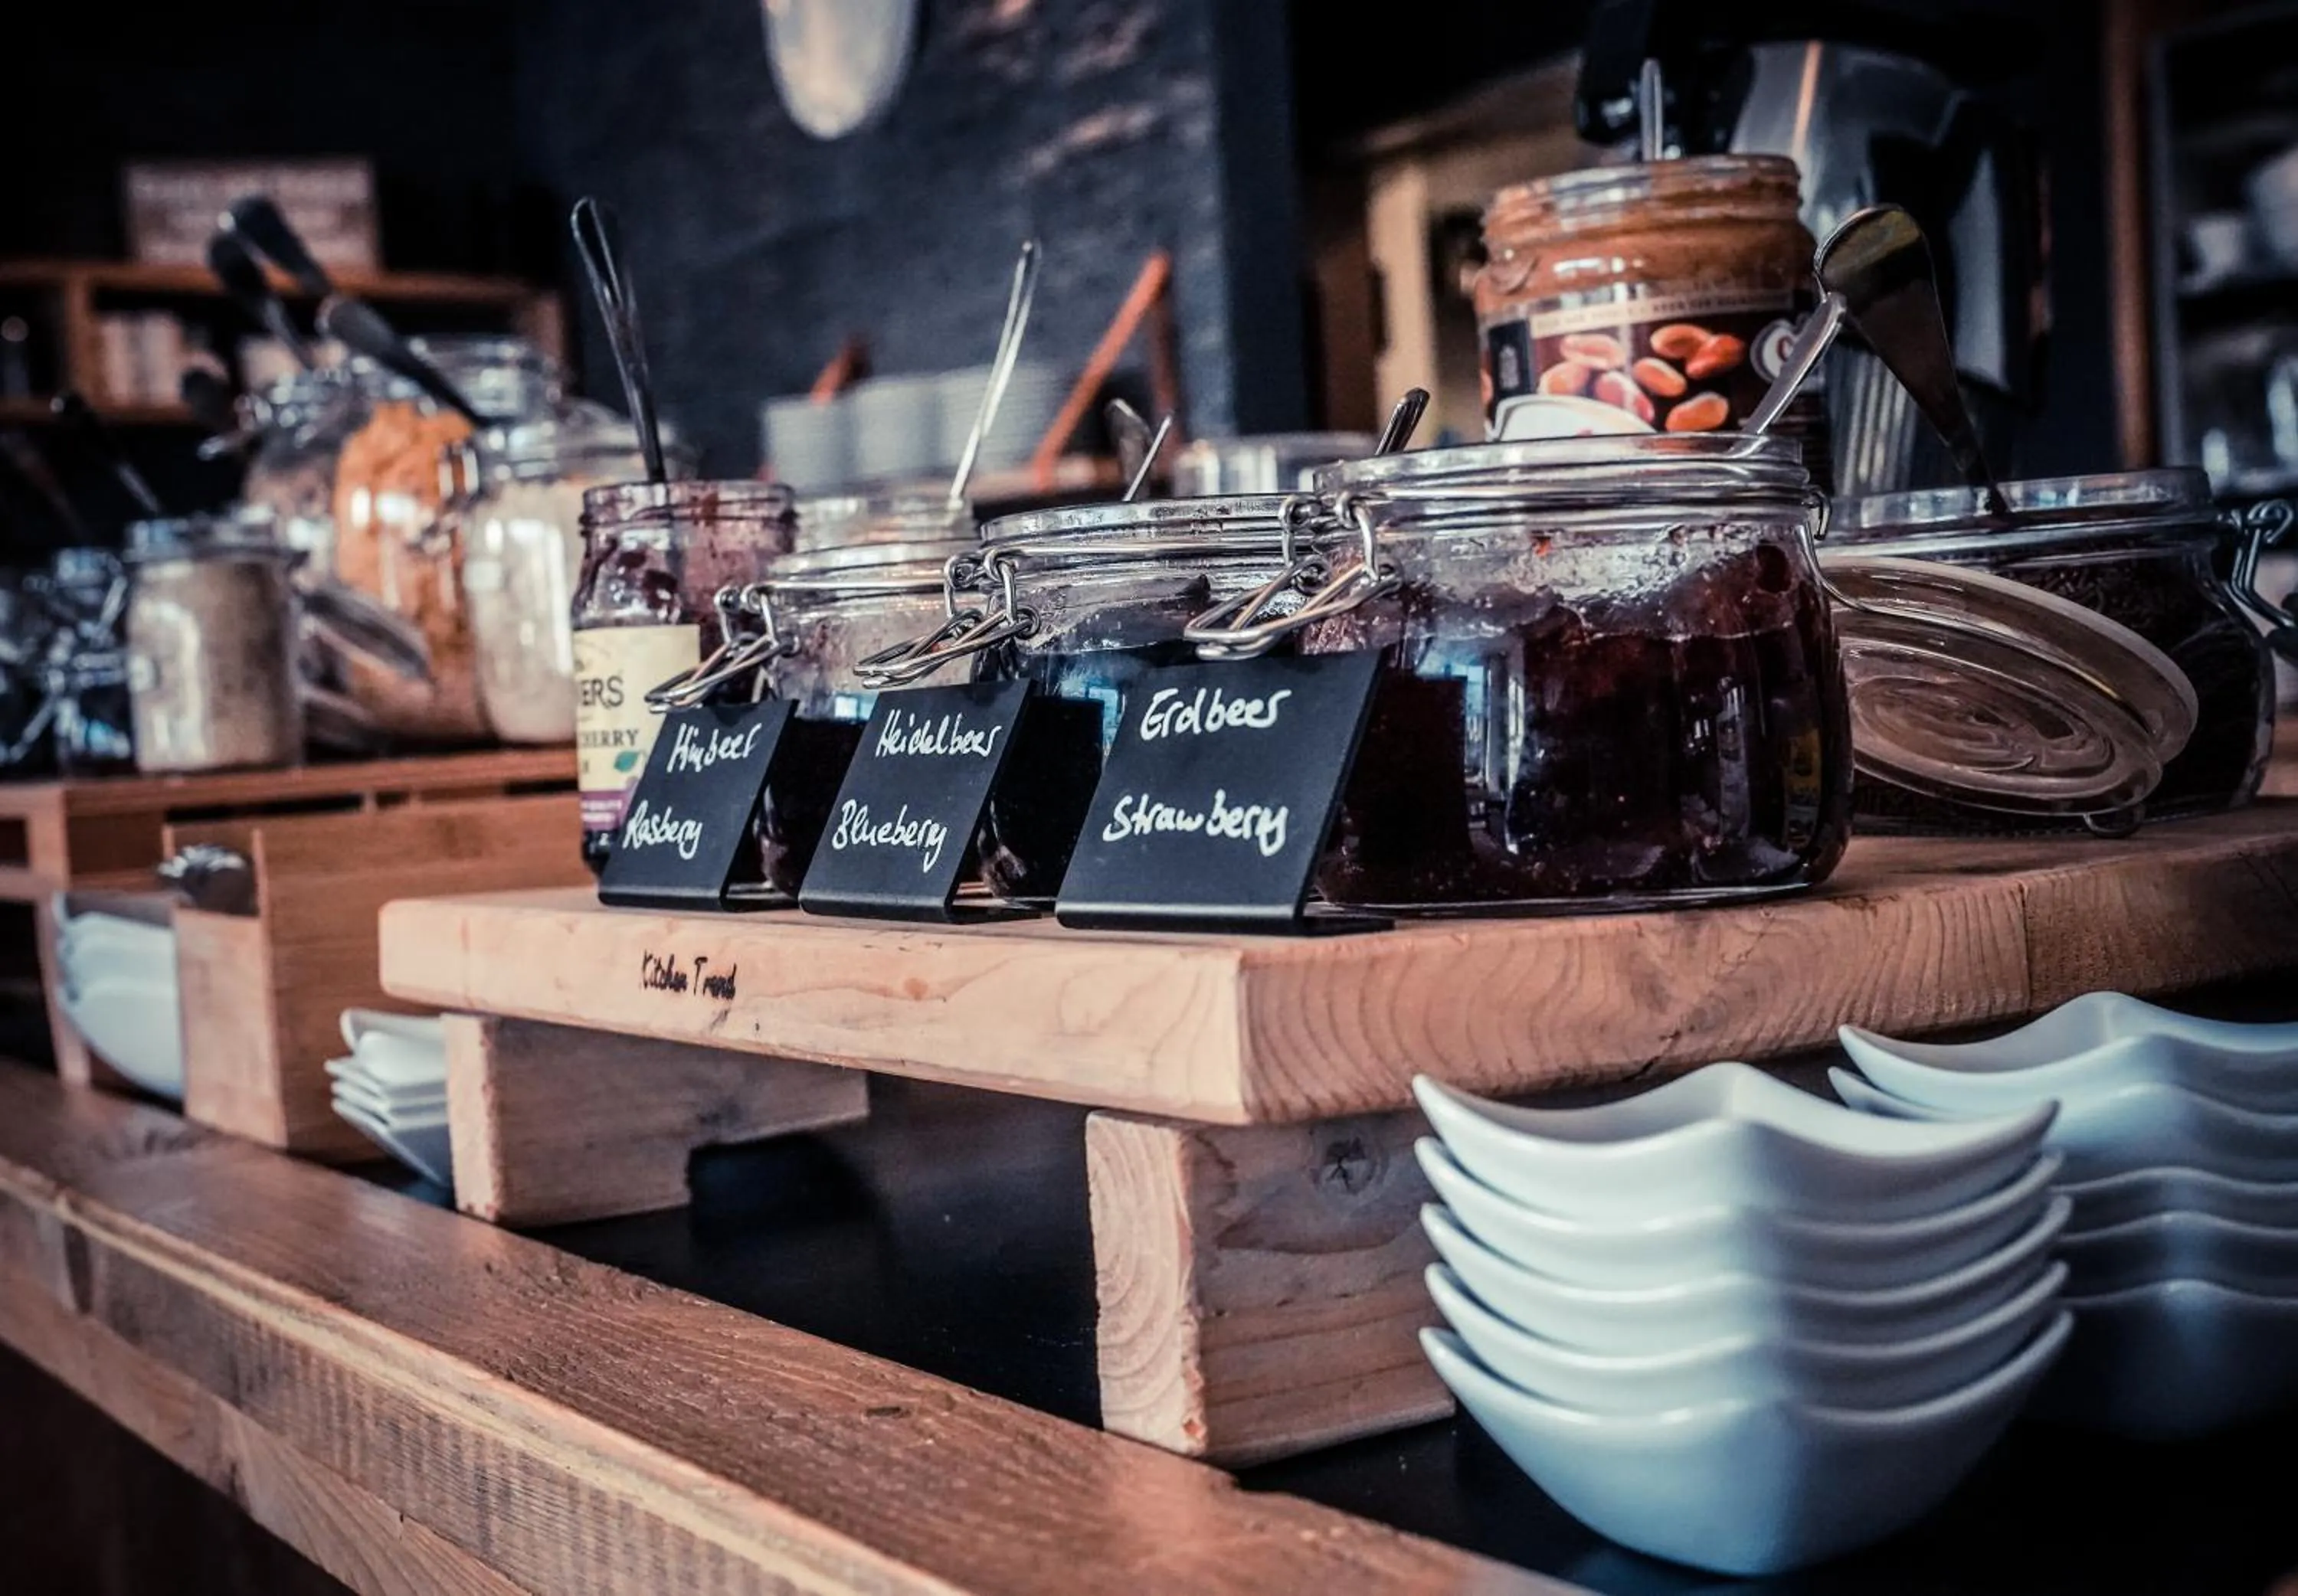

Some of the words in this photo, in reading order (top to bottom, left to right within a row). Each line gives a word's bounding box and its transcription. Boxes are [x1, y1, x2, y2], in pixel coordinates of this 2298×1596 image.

[875, 708, 1003, 757] Heidelbeer
[1140, 687, 1292, 741] Erdbeer
[666, 722, 763, 773] Himbeer
